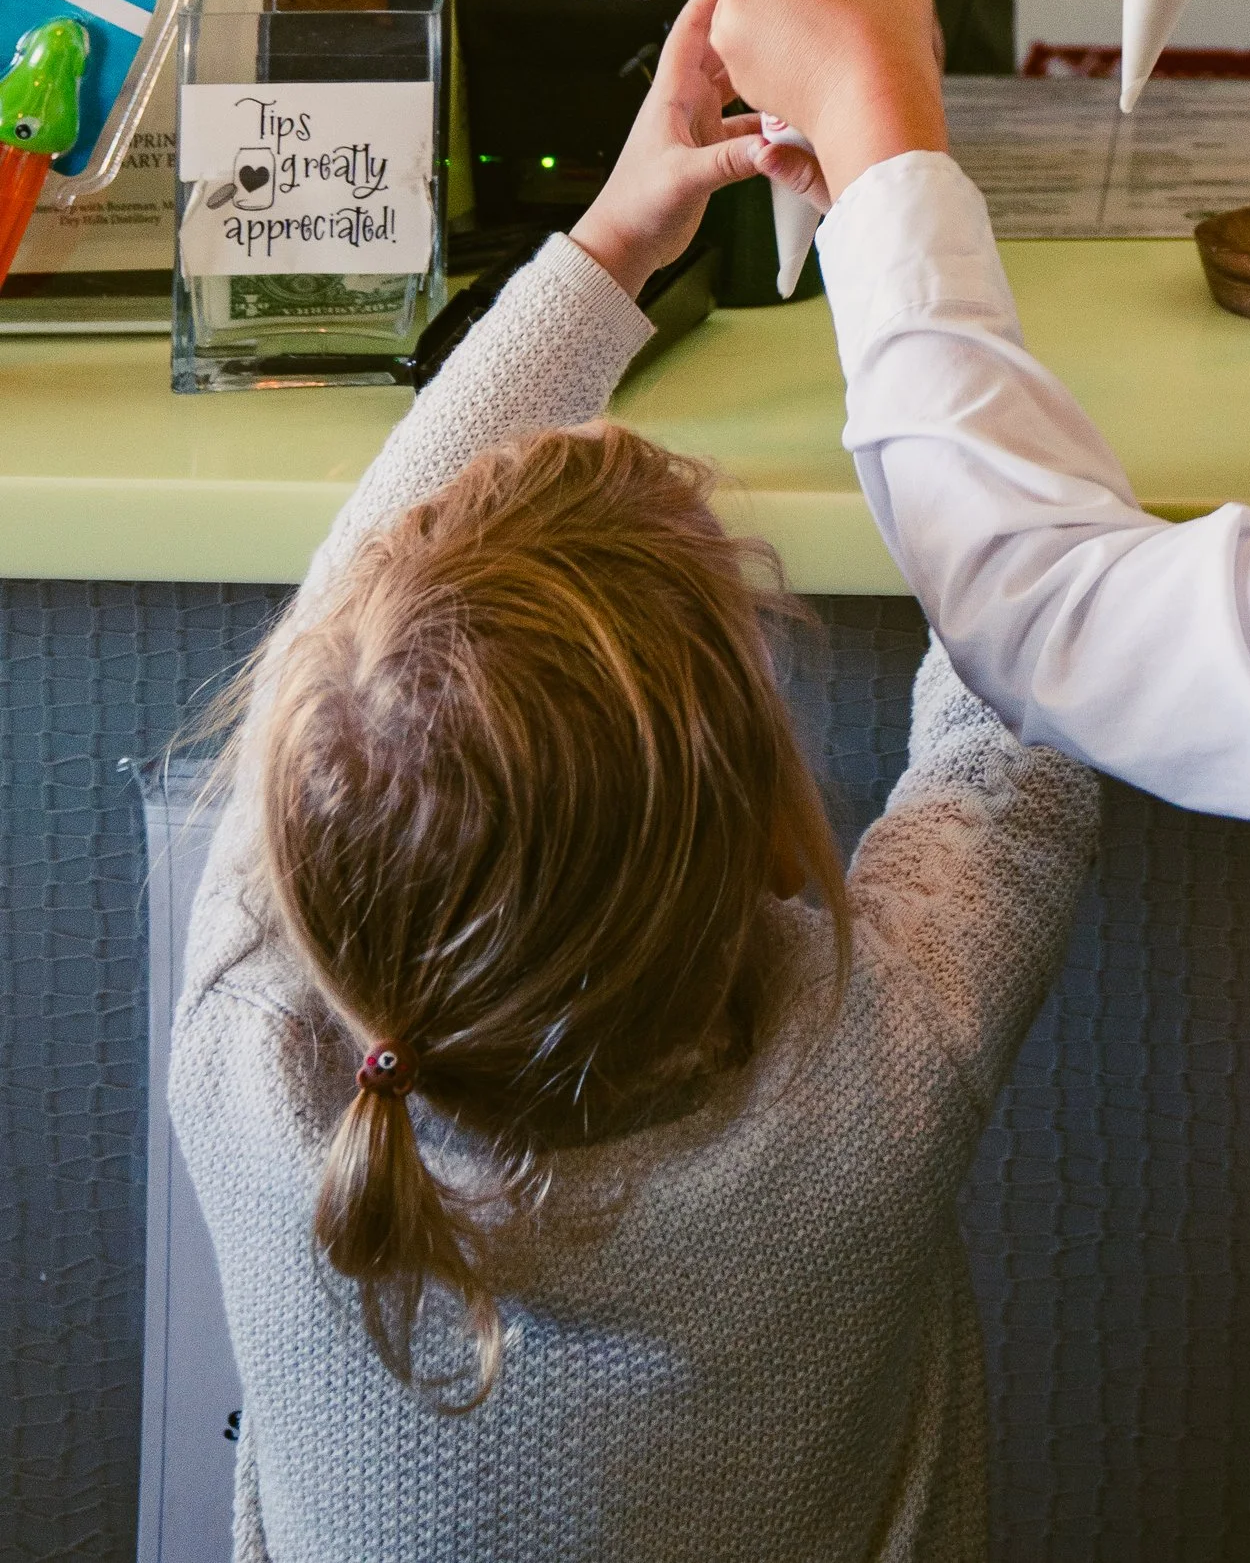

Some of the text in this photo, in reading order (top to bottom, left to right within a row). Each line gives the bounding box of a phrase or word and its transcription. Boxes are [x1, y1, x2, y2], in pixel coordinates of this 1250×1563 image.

[131, 133, 175, 148] PRIN
[234, 97, 312, 155] Tips
[279, 143, 388, 199] greatly
[224, 206, 397, 257] appreciated!
